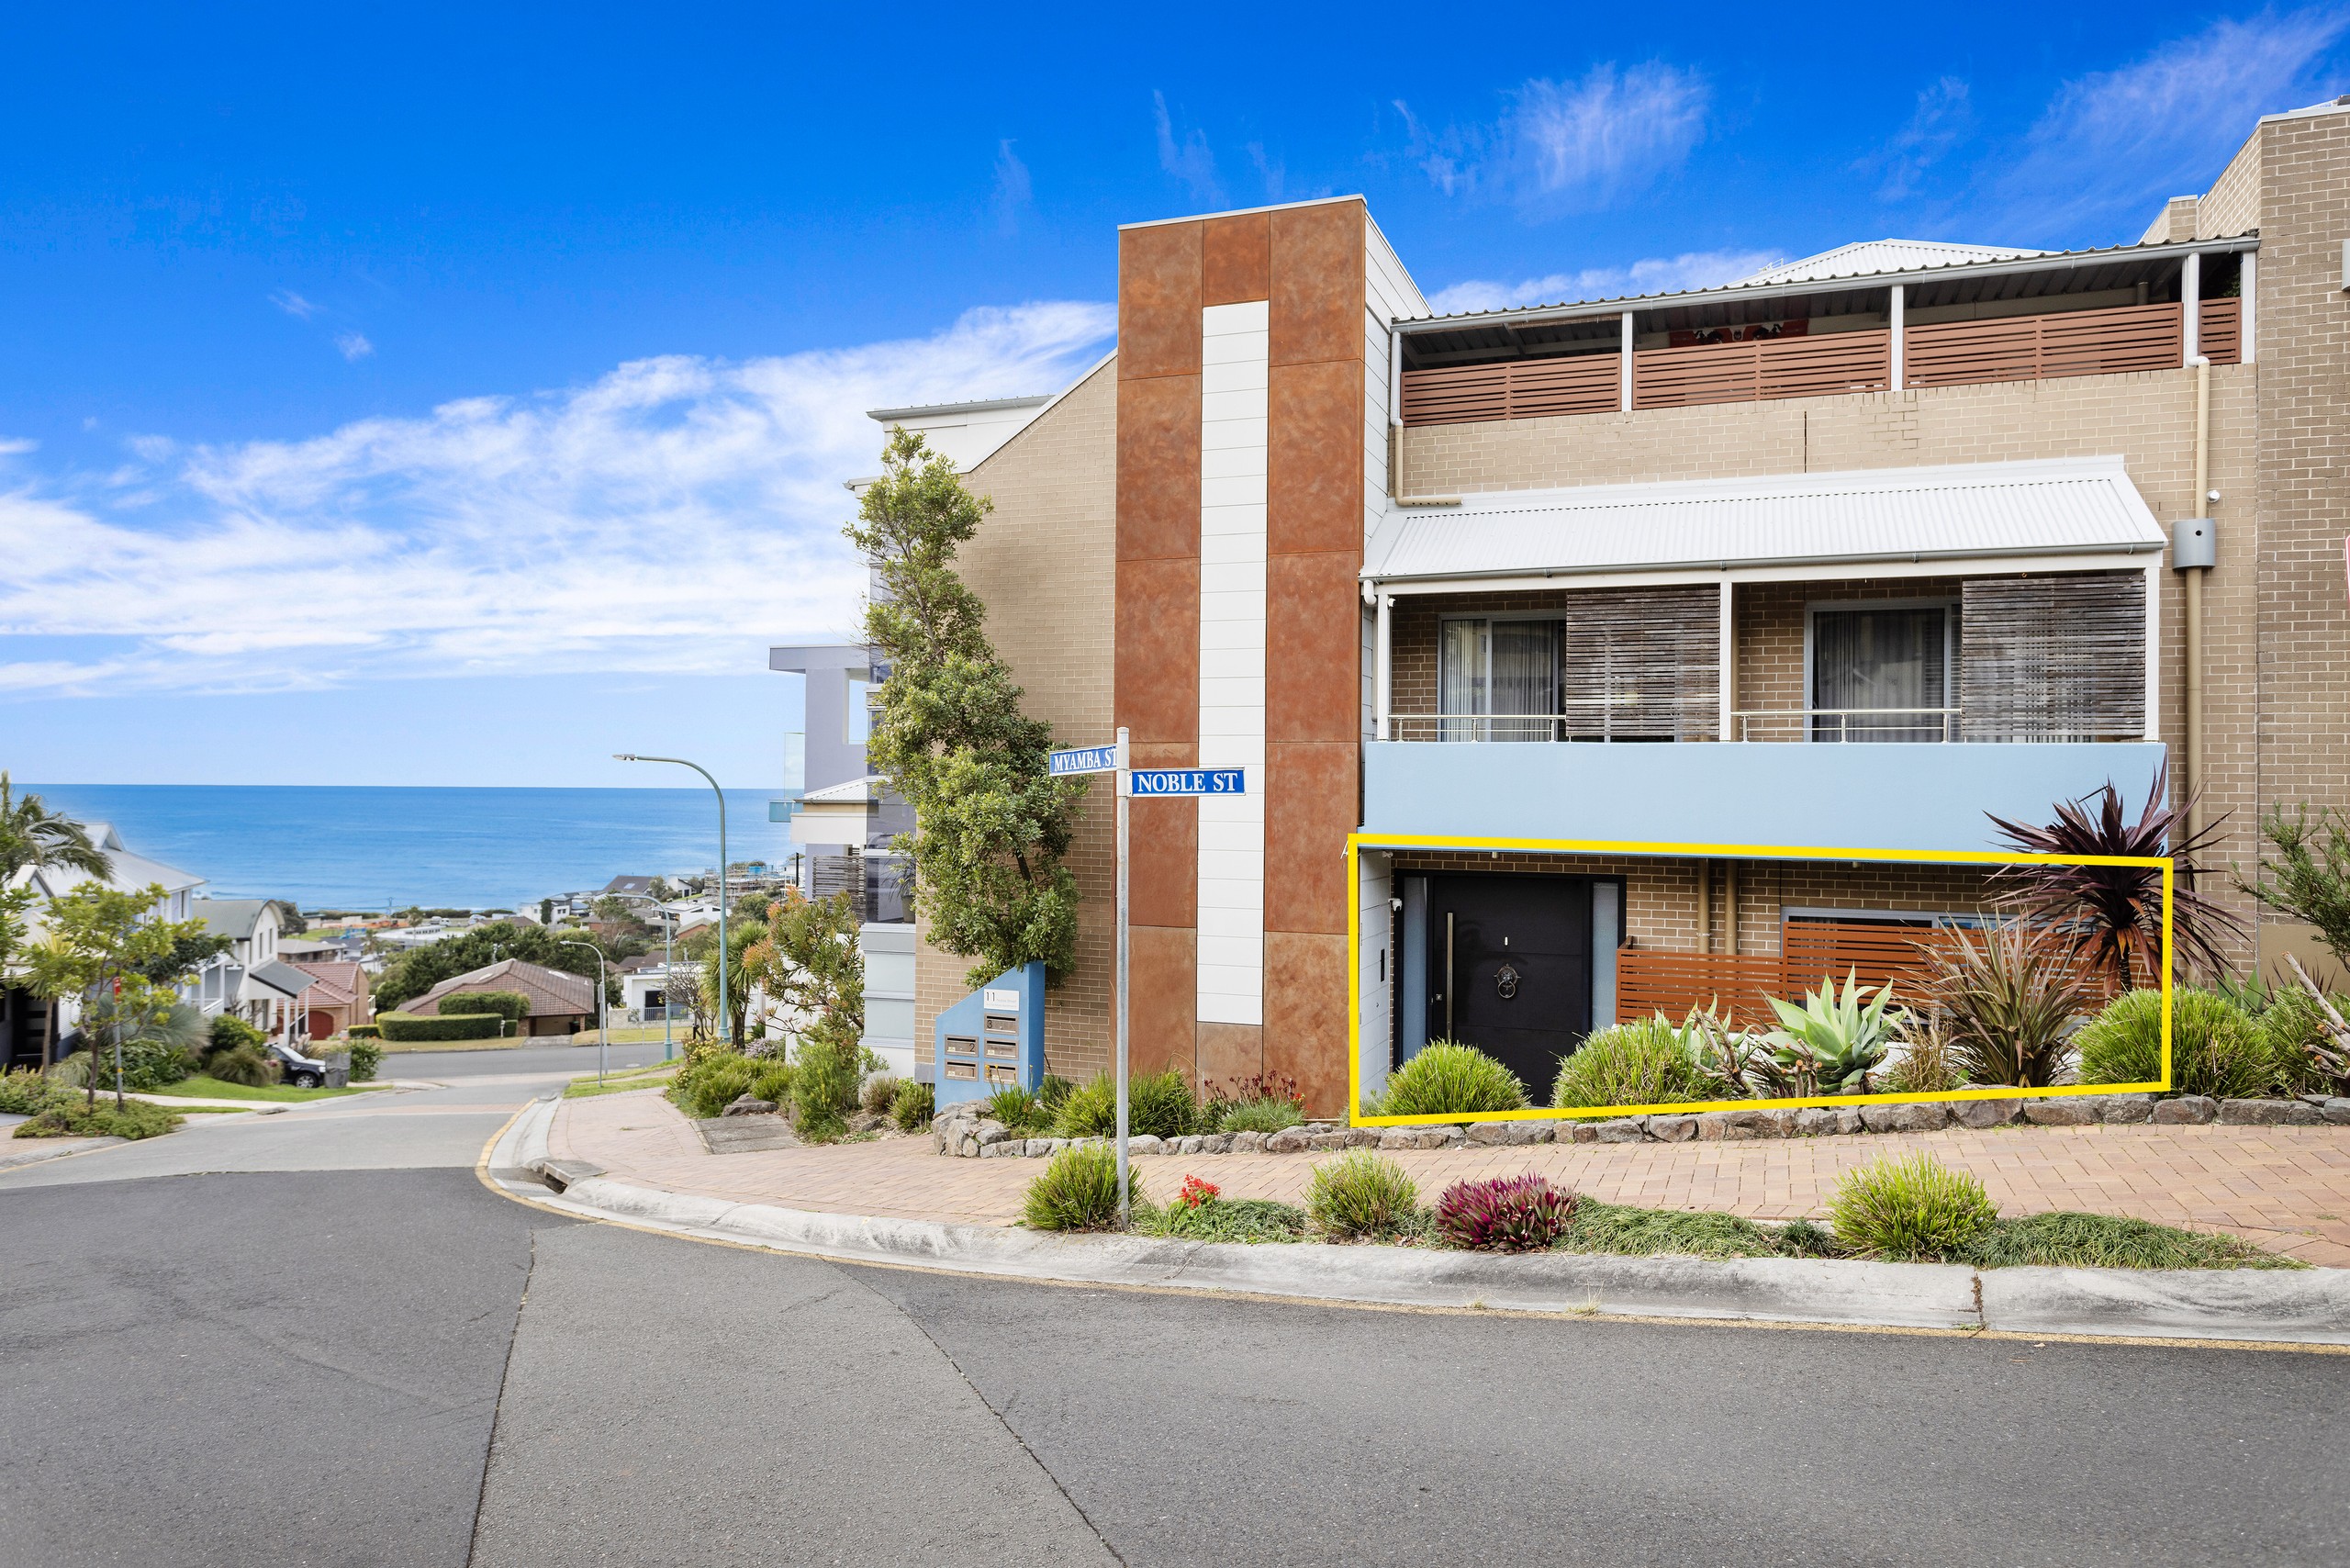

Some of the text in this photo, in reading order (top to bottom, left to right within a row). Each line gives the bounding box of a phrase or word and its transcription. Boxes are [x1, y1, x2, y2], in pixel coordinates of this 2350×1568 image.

[1054, 748, 1117, 772] MYAMBA ST
[1137, 772, 1238, 792] NOBLE ST
[986, 991, 995, 1002] 11
[987, 1020, 993, 1029] 3
[969, 1043, 975, 1052] 2
